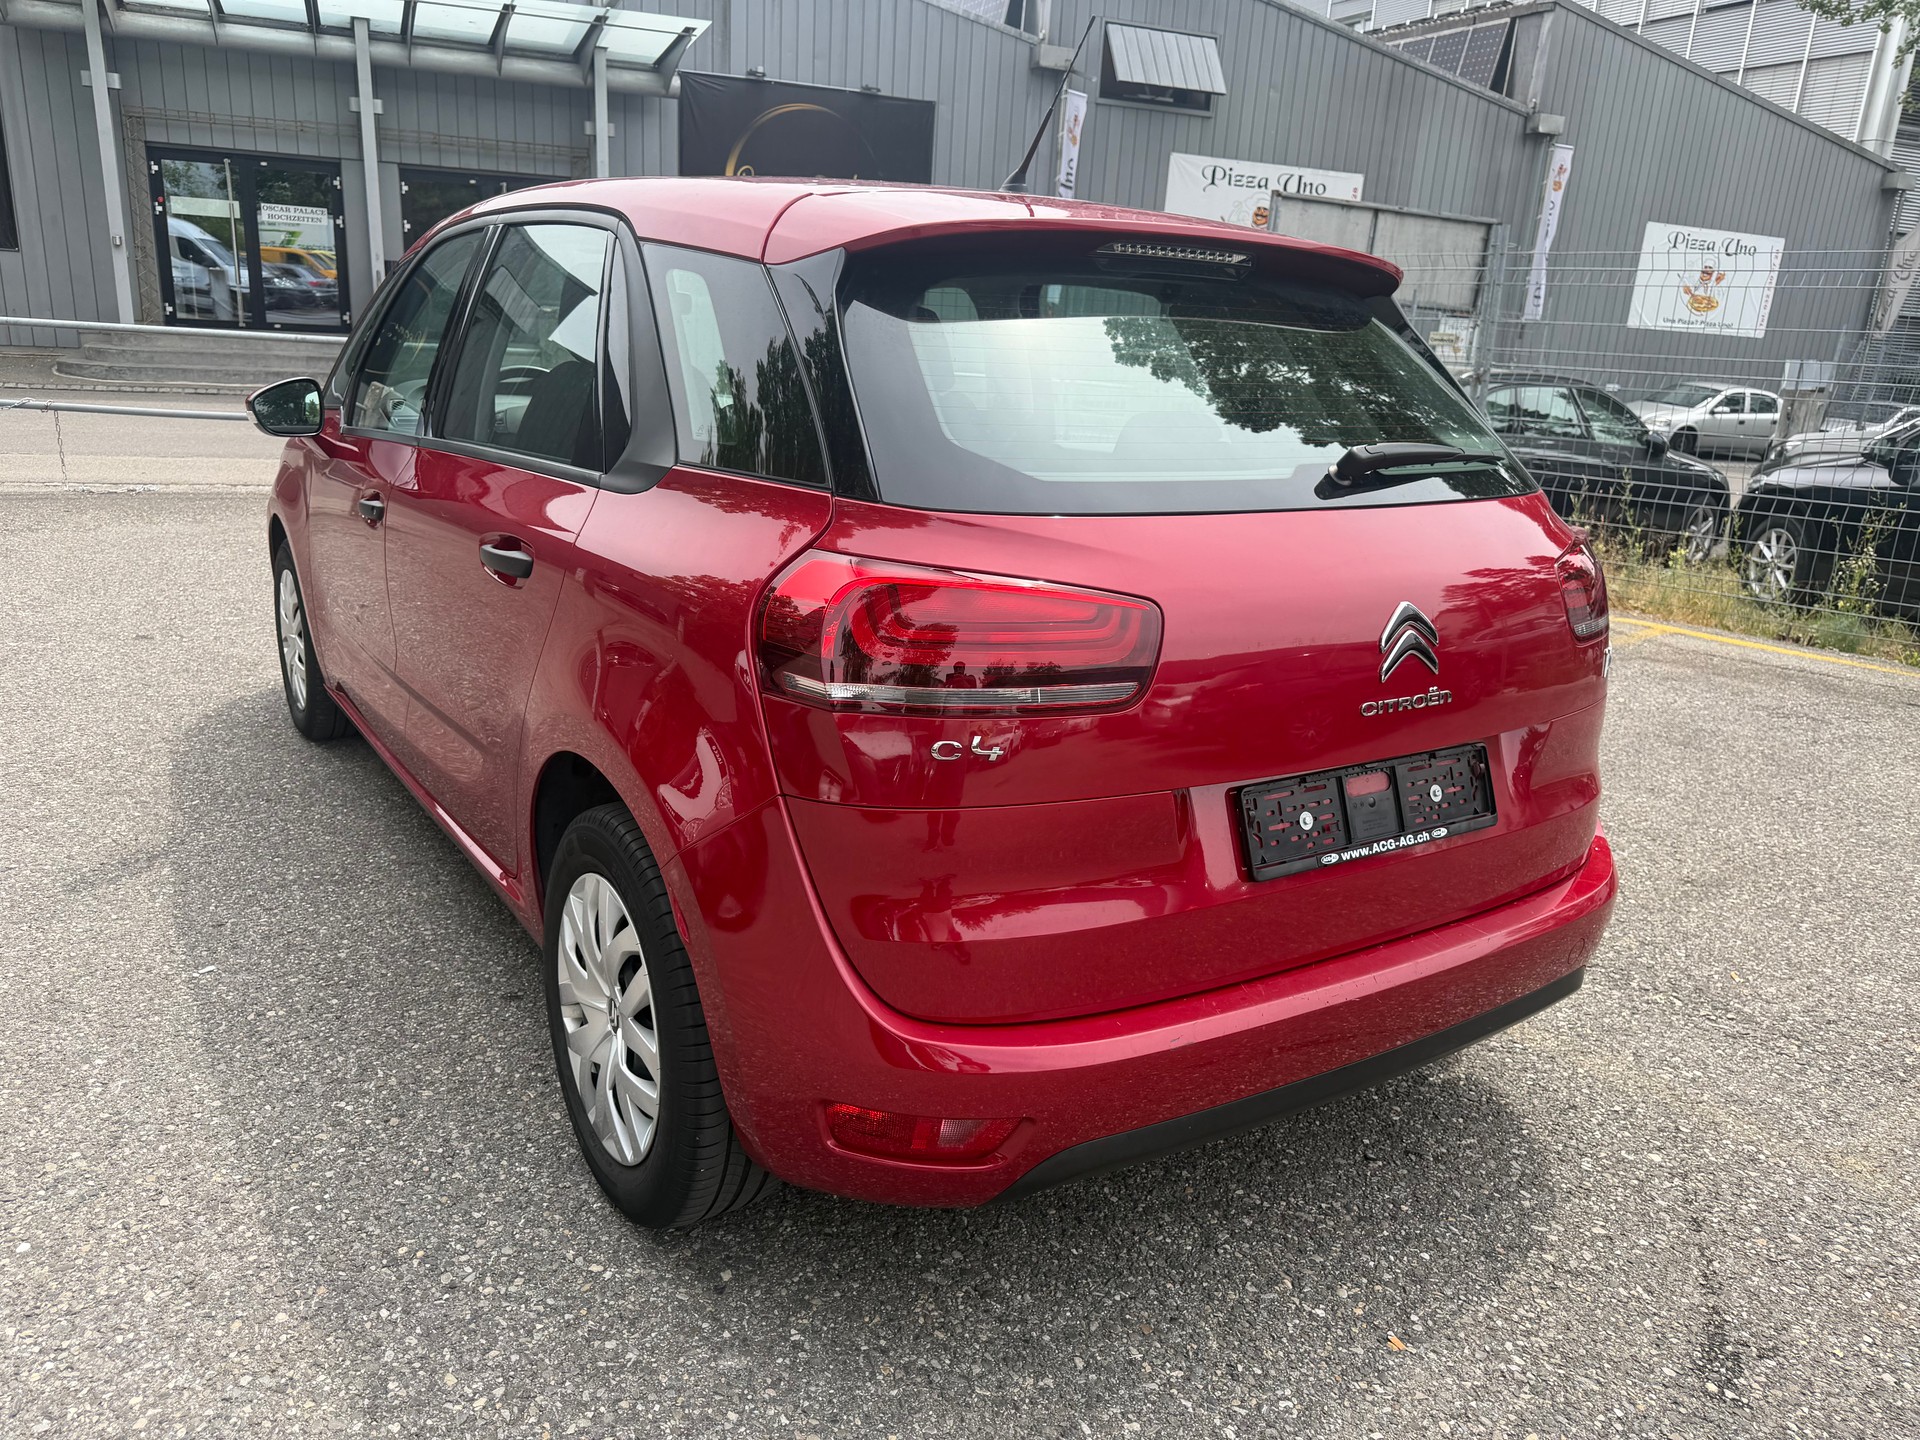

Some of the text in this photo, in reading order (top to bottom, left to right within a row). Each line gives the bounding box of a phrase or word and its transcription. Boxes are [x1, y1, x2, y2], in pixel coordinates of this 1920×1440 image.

[1202, 164, 1327, 196] Pizza Uno
[262, 204, 327, 216] OSCAR PALACE
[267, 213, 323, 223] HOCHZEITEN
[1667, 231, 1757, 257] Pizza Uno
[1340, 831, 1430, 861] www.ACG-AG.ch
